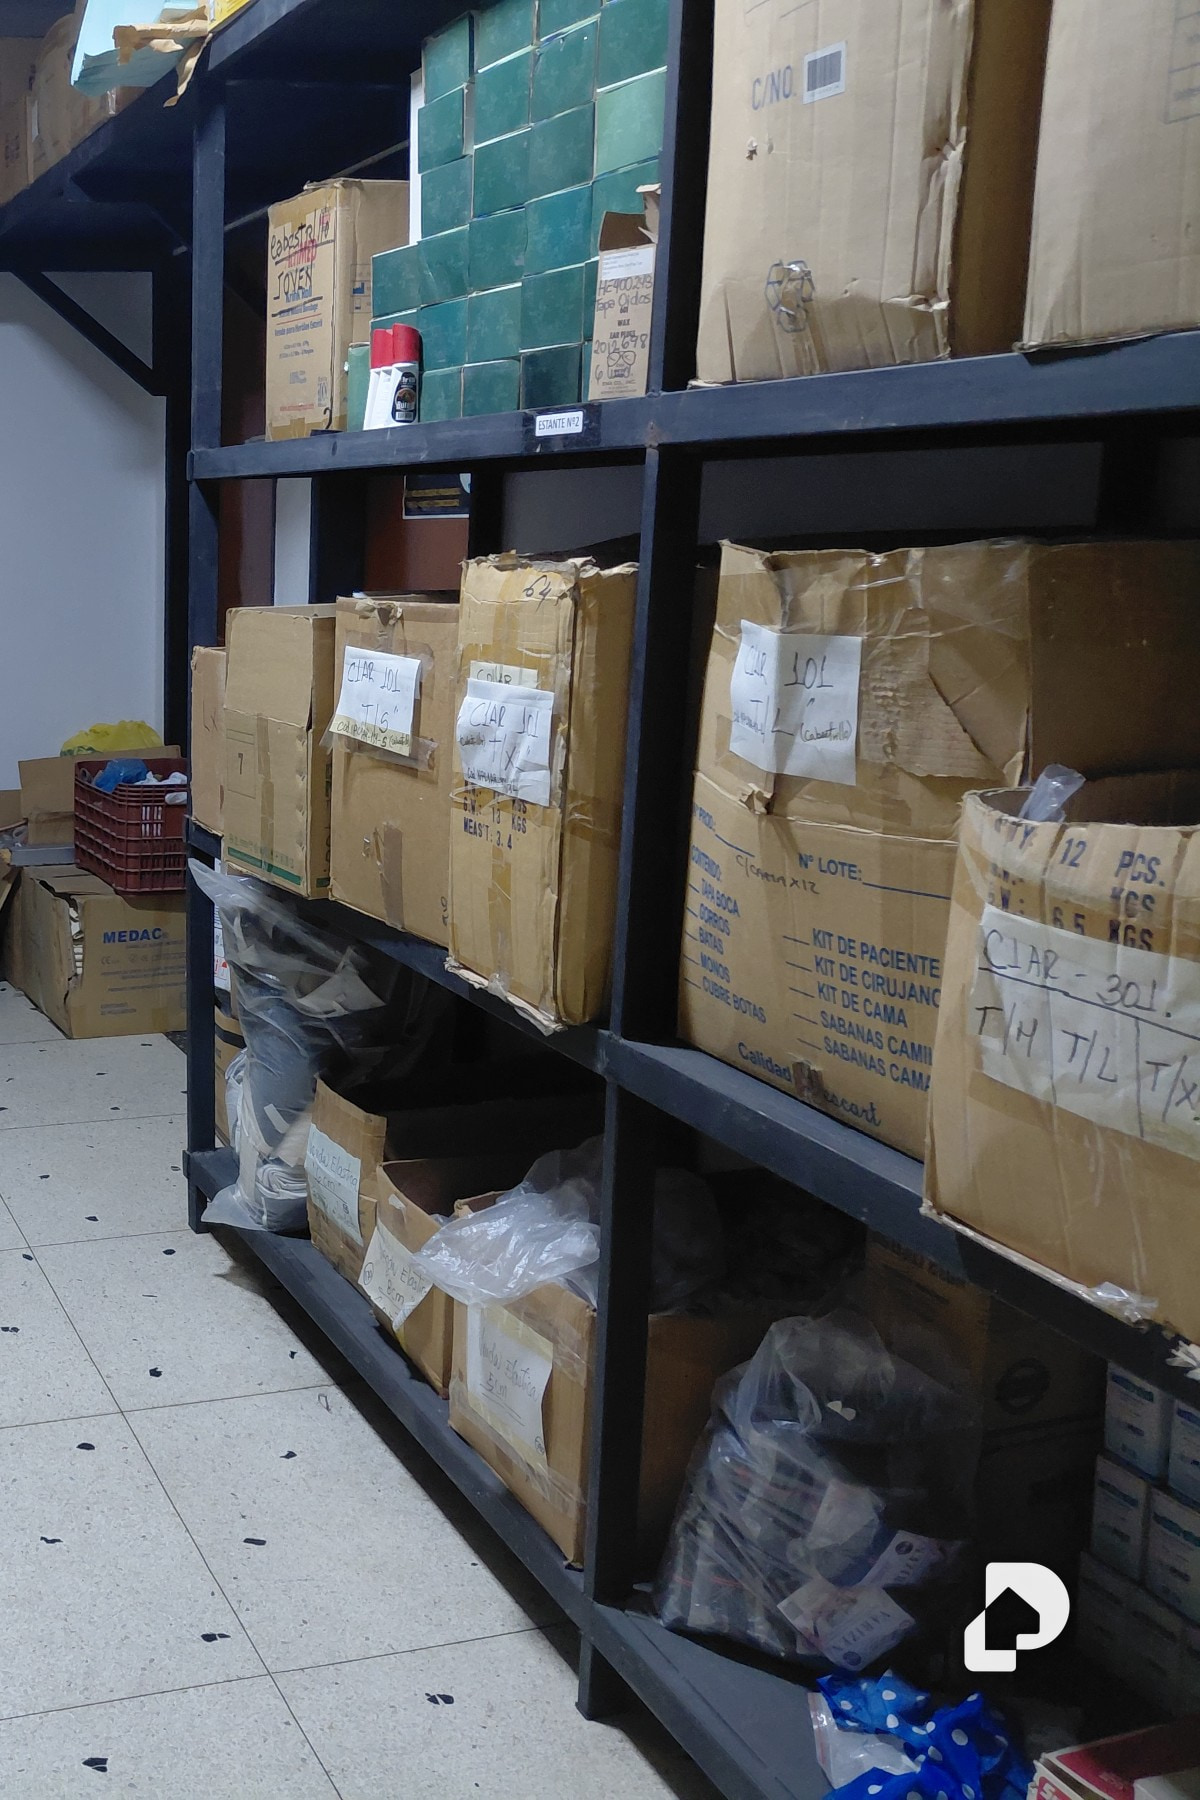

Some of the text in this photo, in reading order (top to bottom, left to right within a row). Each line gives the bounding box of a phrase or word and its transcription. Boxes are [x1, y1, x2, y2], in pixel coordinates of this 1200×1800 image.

[538, 417, 566, 430] ESTANTE
[512, 814, 526, 834] KGS
[1059, 838, 1087, 868] 12
[818, 858, 863, 881] LOTE:
[700, 903, 731, 937] GORROS
[716, 892, 741, 917] BOCA
[103, 928, 162, 944] MEDAC
[699, 927, 724, 955] BATAS
[812, 928, 941, 979] KIT DE PACIENTE
[814, 955, 835, 977] KIT
[839, 962, 858, 986] DE
[702, 975, 767, 1023] CUBRE BOTAS
[817, 981, 908, 1028] KIT DE CAMA
[820, 1010, 884, 1051] SABANAS
[738, 1042, 792, 1083] Calidad
[824, 1036, 887, 1077] SABANAS
